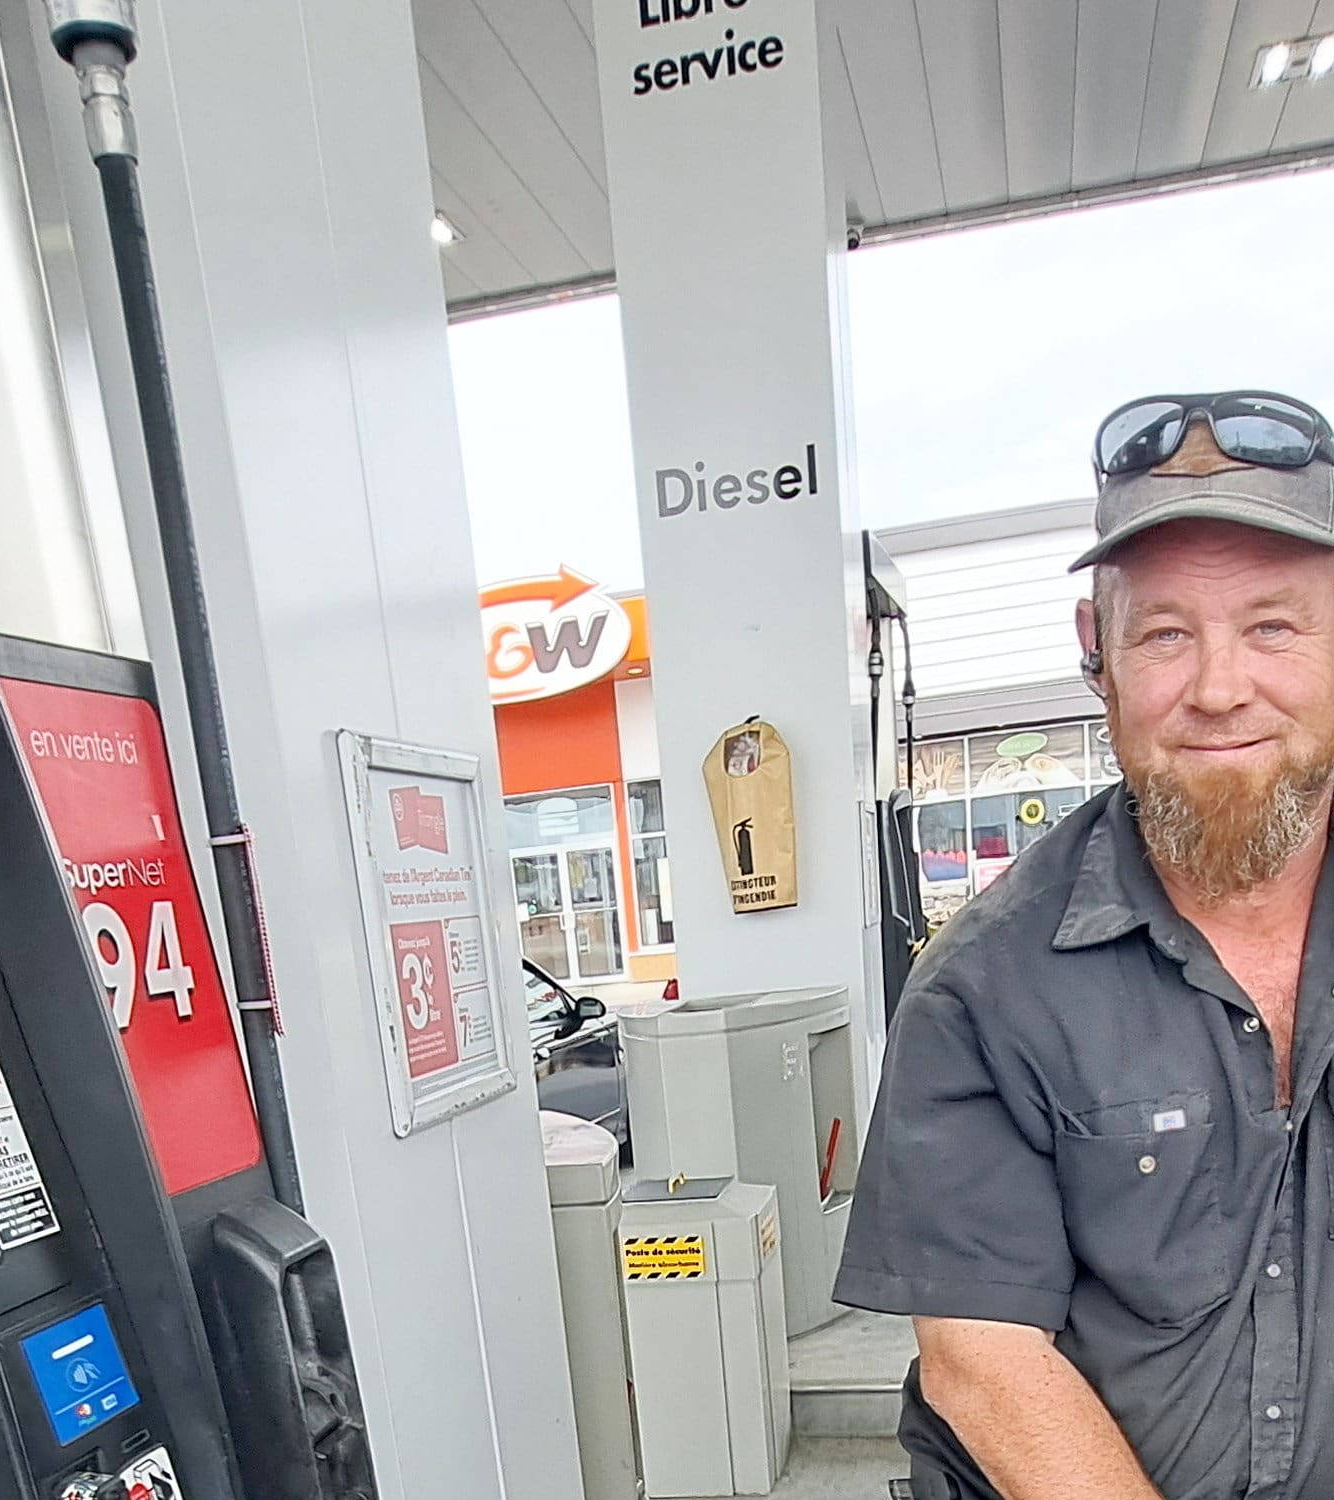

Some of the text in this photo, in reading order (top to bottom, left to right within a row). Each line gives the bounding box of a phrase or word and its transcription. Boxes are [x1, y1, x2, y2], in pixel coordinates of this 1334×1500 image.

[633, 29, 784, 95] service
[655, 444, 819, 518] Diesel
[31, 729, 138, 765] en vente ici
[61, 857, 166, 895] SuperNet
[81, 900, 195, 1031] 94
